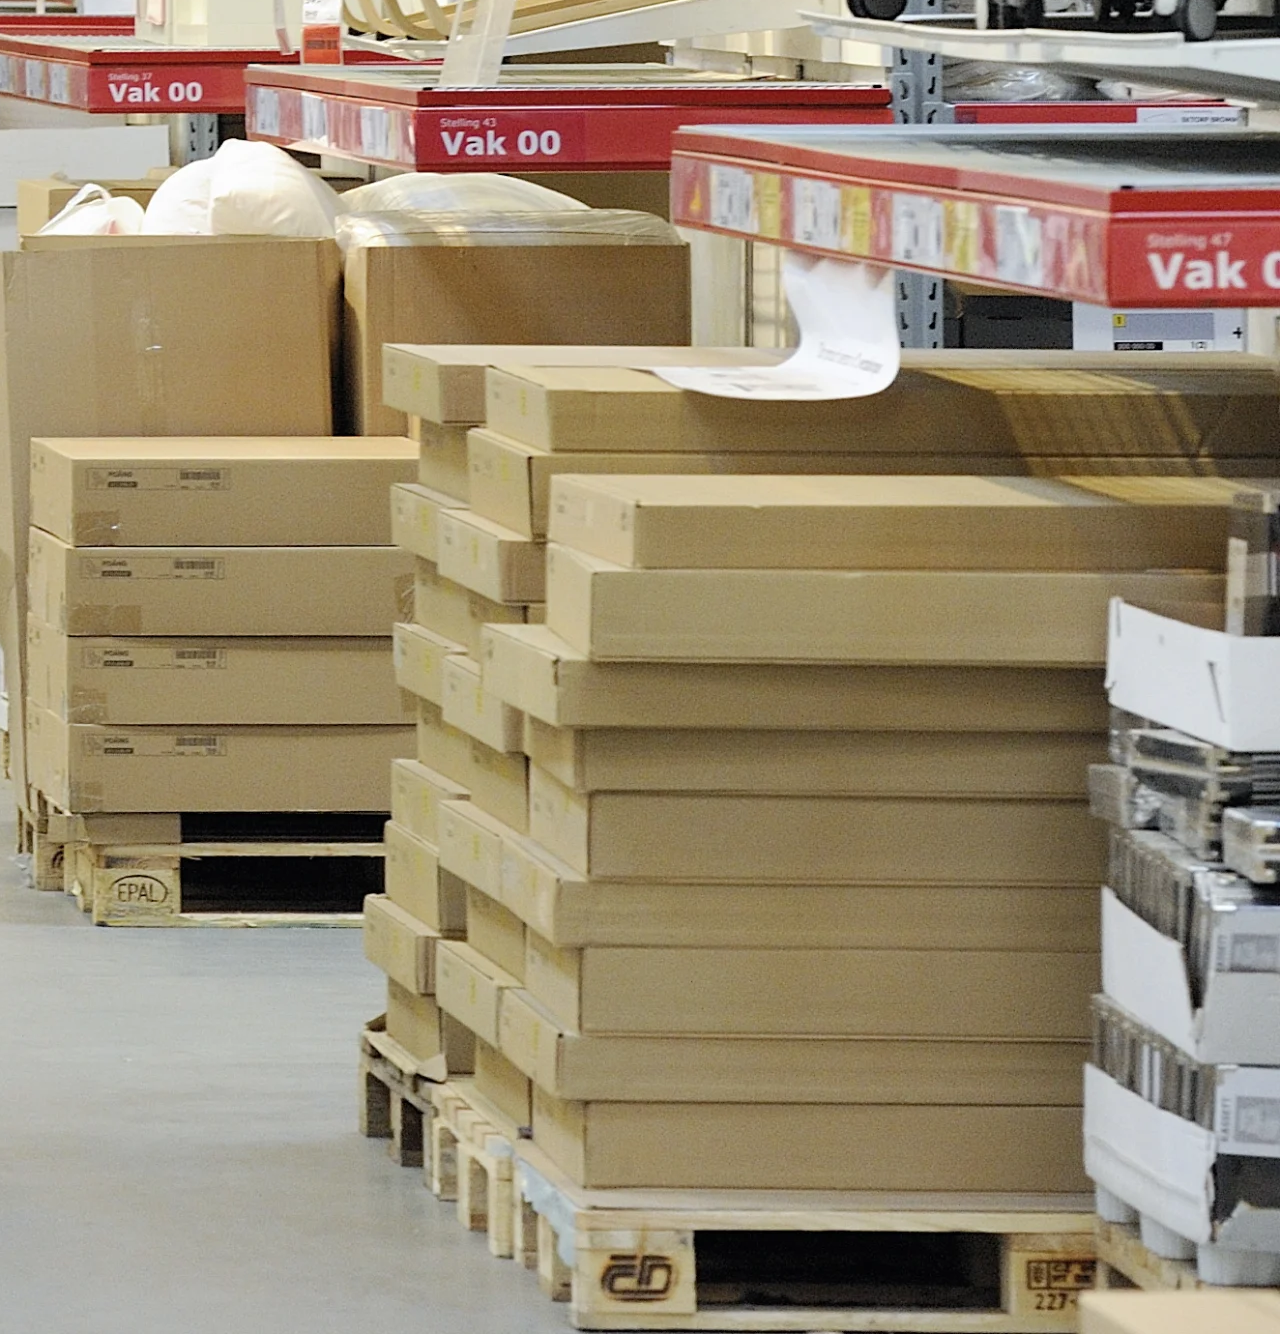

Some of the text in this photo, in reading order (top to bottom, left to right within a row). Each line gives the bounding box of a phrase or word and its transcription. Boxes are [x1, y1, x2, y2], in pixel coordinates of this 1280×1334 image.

[107, 72, 139, 83] Stelling
[109, 82, 202, 103] Vak 00
[440, 117, 497, 130] Stelling 43
[441, 129, 561, 157] Vak 00
[1147, 250, 1248, 291] Vak
[117, 883, 160, 903] EPAL
